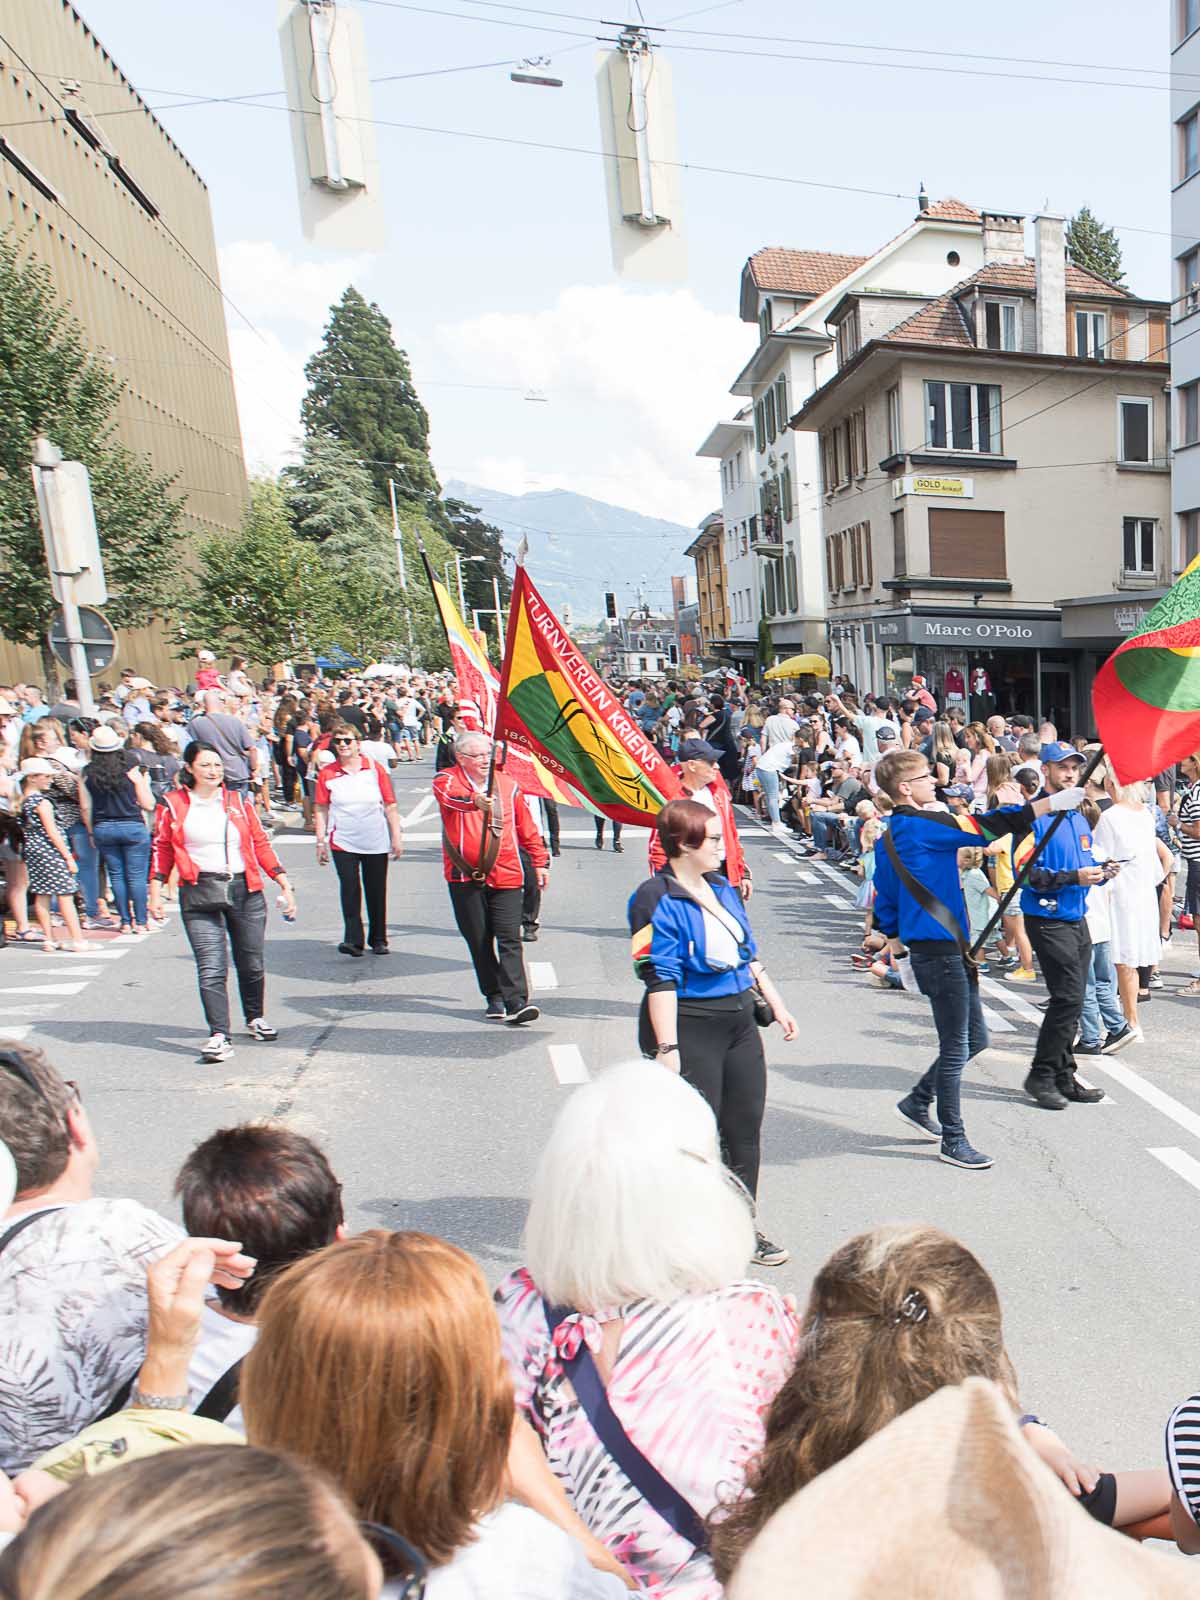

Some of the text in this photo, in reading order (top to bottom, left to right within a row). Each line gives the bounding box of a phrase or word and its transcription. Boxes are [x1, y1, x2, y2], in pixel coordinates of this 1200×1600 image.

[917, 479, 941, 489] GOLD
[925, 623, 1033, 639] Marc O'Polo
[526, 591, 660, 772] TURNVEREIN KRIENS
